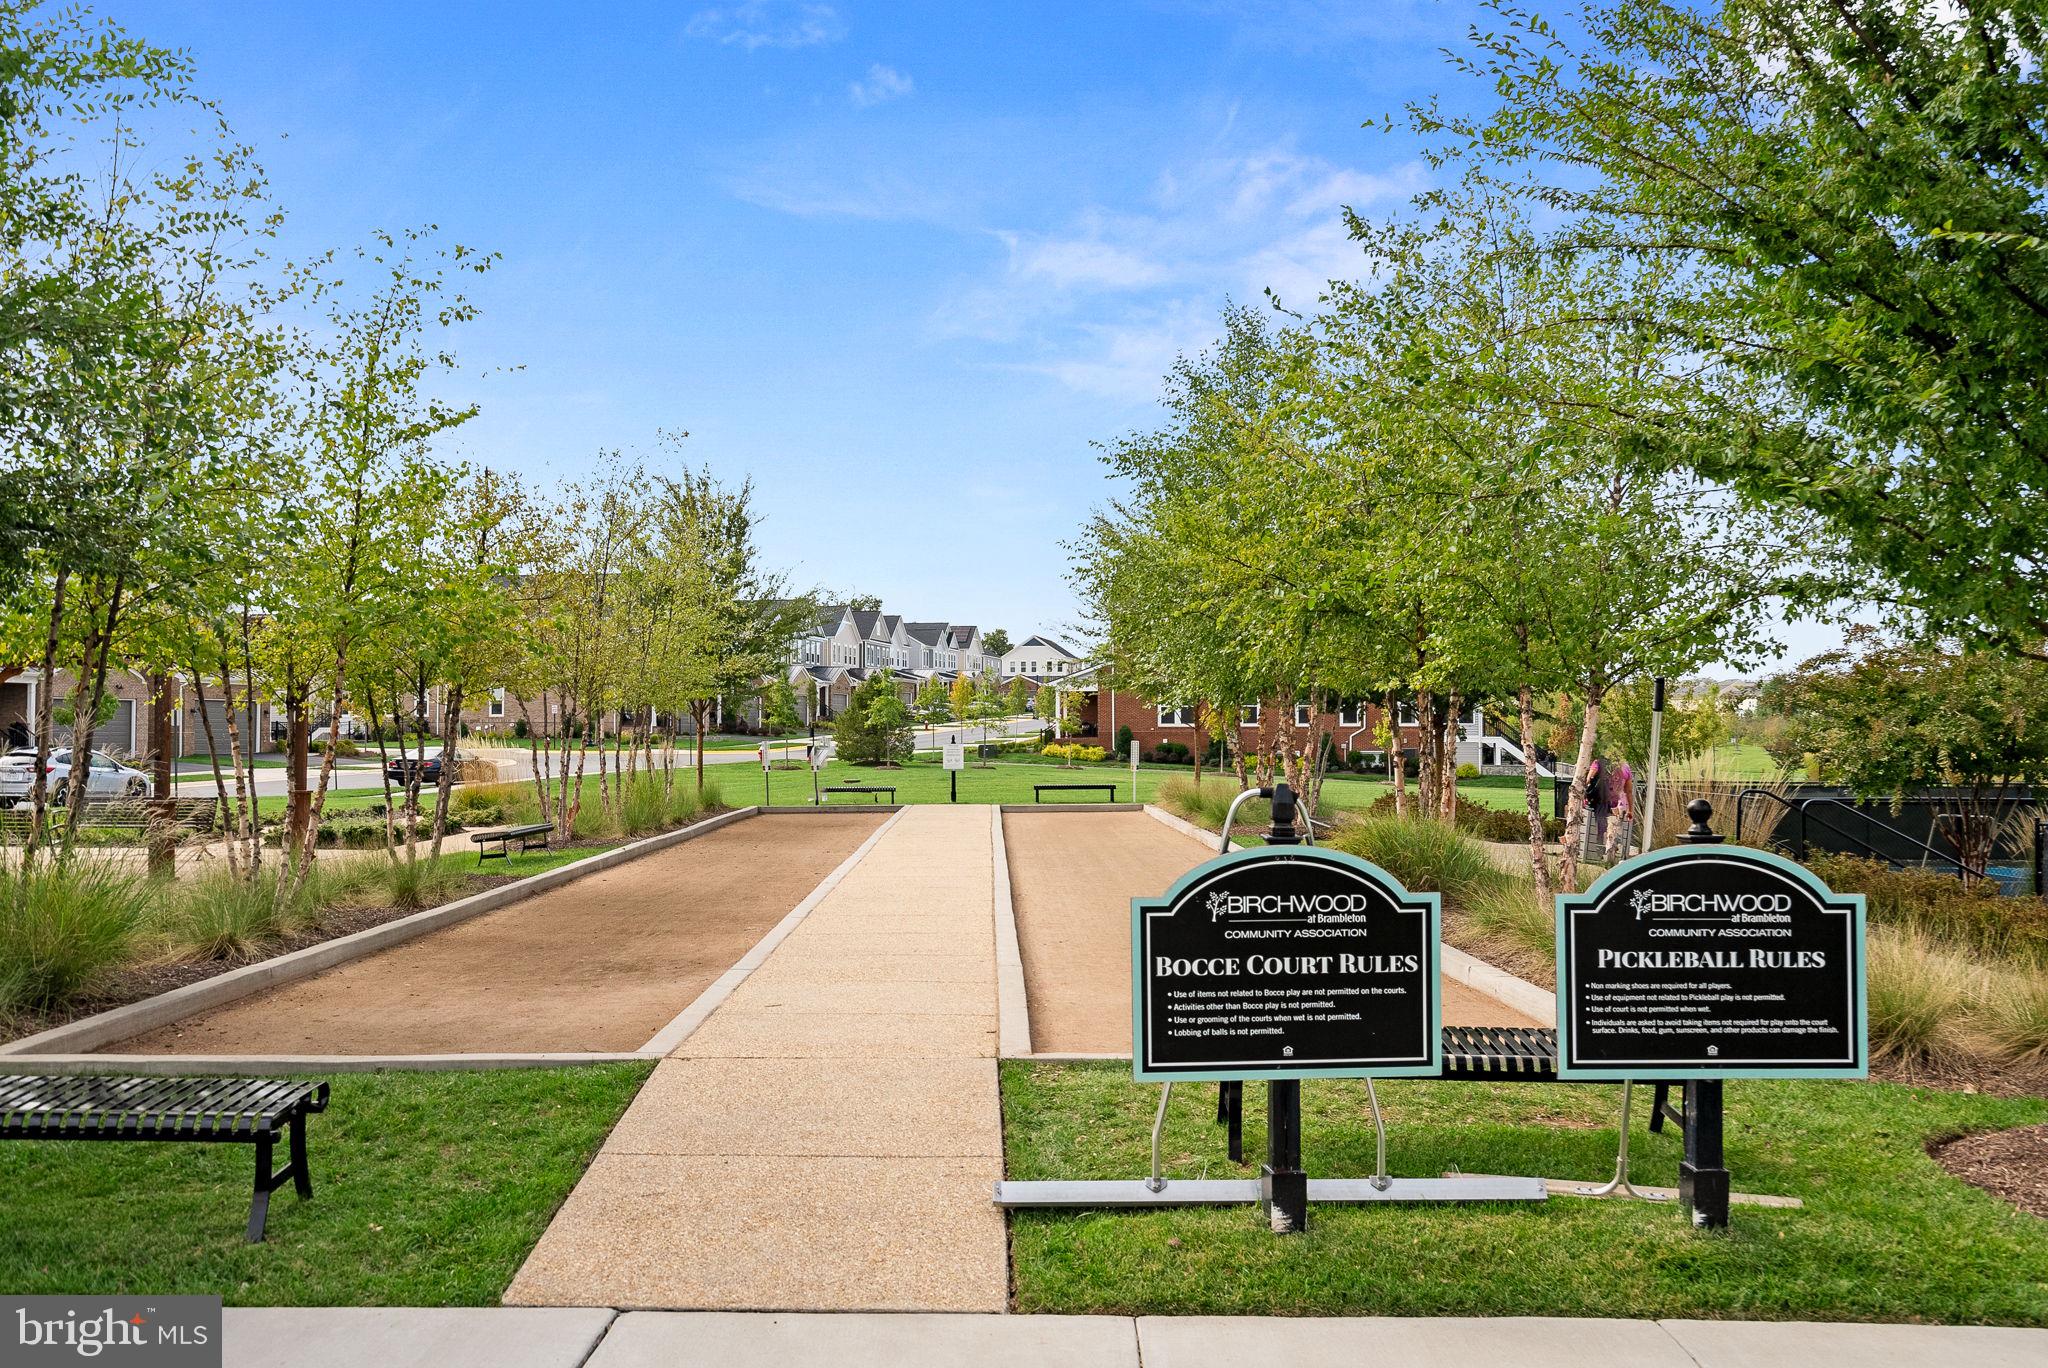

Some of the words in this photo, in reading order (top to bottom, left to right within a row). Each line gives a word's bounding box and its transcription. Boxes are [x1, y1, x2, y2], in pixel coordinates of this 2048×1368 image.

[1227, 895, 1366, 913] BIRCHWOOD
[1652, 895, 1791, 912] BIRCHWOOD
[1307, 915, 1316, 923] at
[1317, 913, 1366, 923] Brambleton
[1731, 914, 1741, 922] at
[1741, 914, 1791, 923] Brambleton
[1224, 930, 1292, 939] COMMUNITY
[1294, 929, 1367, 938] ASSOCIATION
[1649, 929, 1716, 937] COMMUNITY
[1718, 929, 1792, 937] ASSOCIATION
[1605, 982, 1631, 990] marking
[1662, 982, 1687, 990] required
[1174, 990, 1187, 998] Use
[1230, 990, 1254, 998] related
[1264, 988, 1285, 996] Bocce
[1286, 988, 1300, 998] play
[1327, 988, 1359, 996] permitted
[1384, 986, 1406, 994] courts.
[1174, 1004, 1205, 1012] Activities
[1206, 1002, 1224, 1010] other
[1225, 1002, 1241, 1010] than
[1243, 1002, 1263, 1010] Bocce
[1265, 1002, 1279, 1010] play
[1301, 1000, 1335, 1010] permitted.
[1197, 1016, 1229, 1024] grooming
[1230, 1014, 1237, 1022] of
[1251, 1014, 1272, 1022] courts
[1307, 1014, 1313, 1022] is
[1327, 1012, 1362, 1022] permitted.
[1682, 1020, 1702, 1028] taking
[1174, 1028, 1202, 1038] Lobbing
[1203, 1028, 1210, 1036] of
[1237, 1028, 1248, 1036] not
[1250, 1028, 1284, 1036] permitted.
[1741, 1026, 1768, 1034] products
[1782, 1026, 1806, 1034] damage
